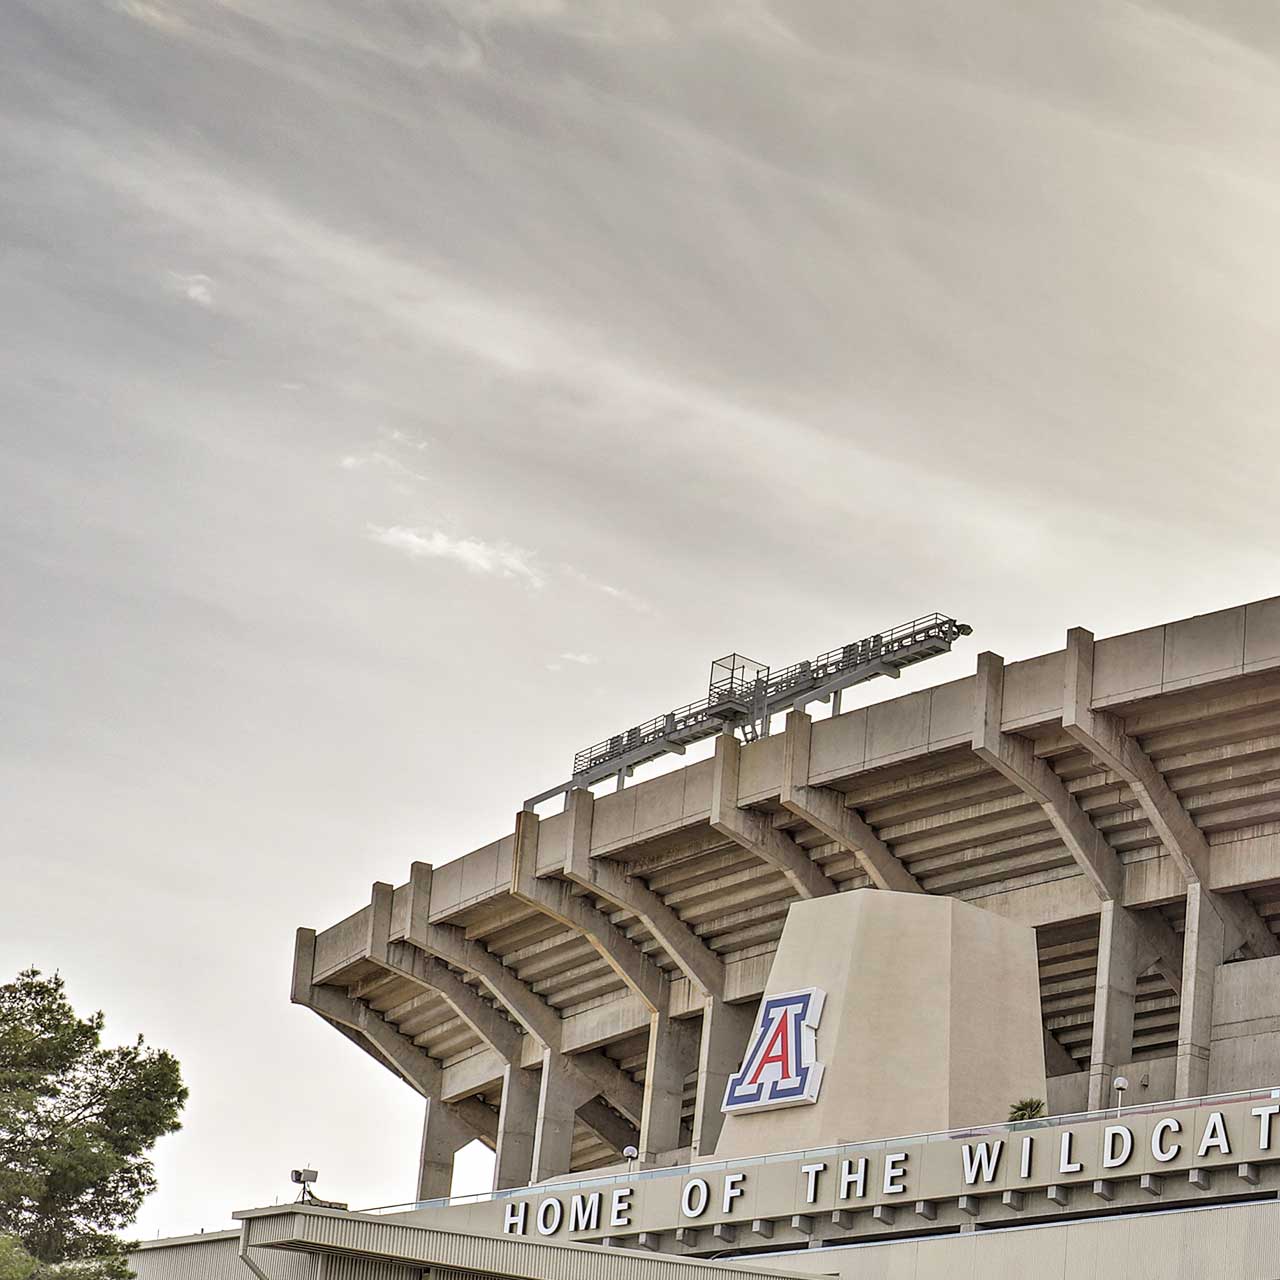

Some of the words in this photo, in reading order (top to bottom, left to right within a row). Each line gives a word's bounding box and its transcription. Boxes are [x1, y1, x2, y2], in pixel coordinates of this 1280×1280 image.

[721, 987, 826, 1116] A
[503, 1187, 633, 1236] HOME
[681, 1173, 746, 1218] OF
[801, 1152, 910, 1203] THE
